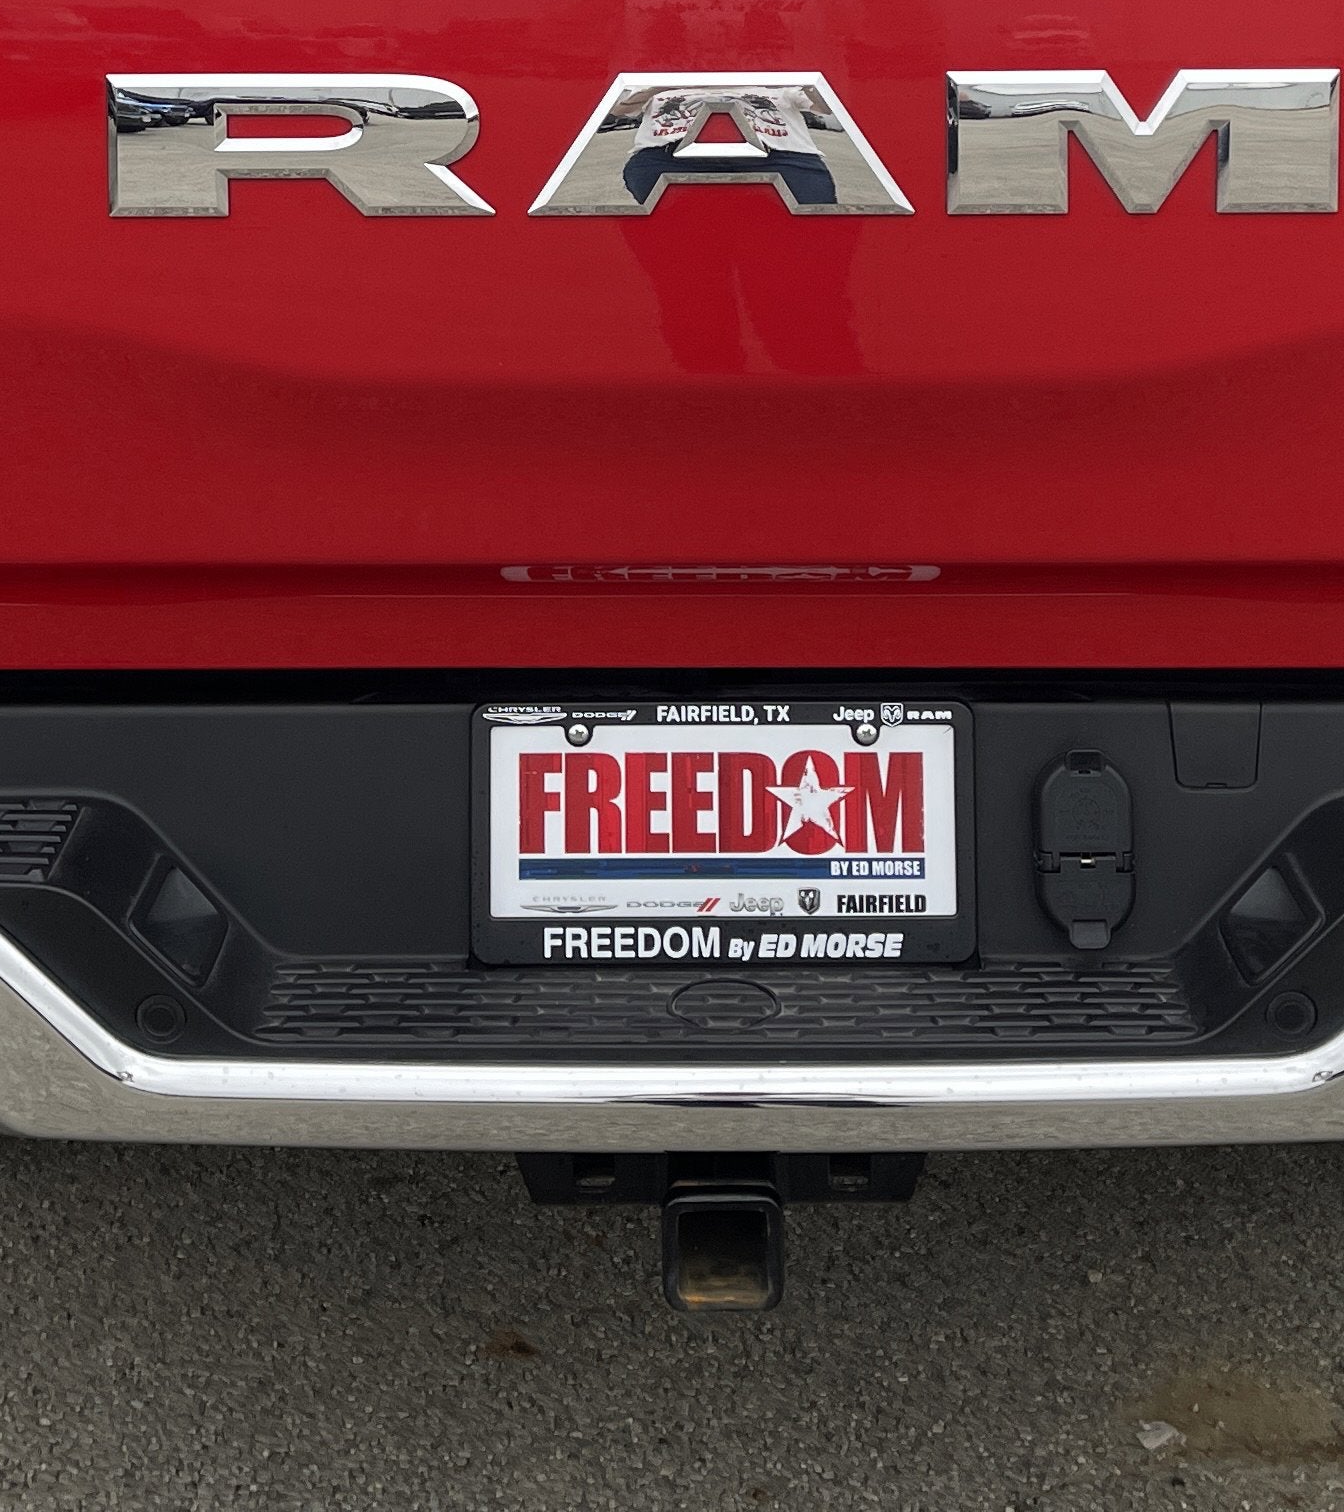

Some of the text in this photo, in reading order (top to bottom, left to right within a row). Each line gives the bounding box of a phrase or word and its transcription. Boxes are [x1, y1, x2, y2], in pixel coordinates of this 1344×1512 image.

[106, 69, 1340, 218] RAM
[572, 711, 626, 719] DODGE
[656, 705, 790, 725] FAIRFIELD, TX
[833, 706, 875, 723] Jeep
[906, 711, 952, 720] RAM
[519, 749, 925, 855] FREEDOM
[830, 861, 921, 876] BY ED MORSE
[729, 893, 785, 913] Jeep
[837, 894, 927, 913] FAIRFIELD
[543, 927, 904, 961] FREEDOM By ED MORSE
